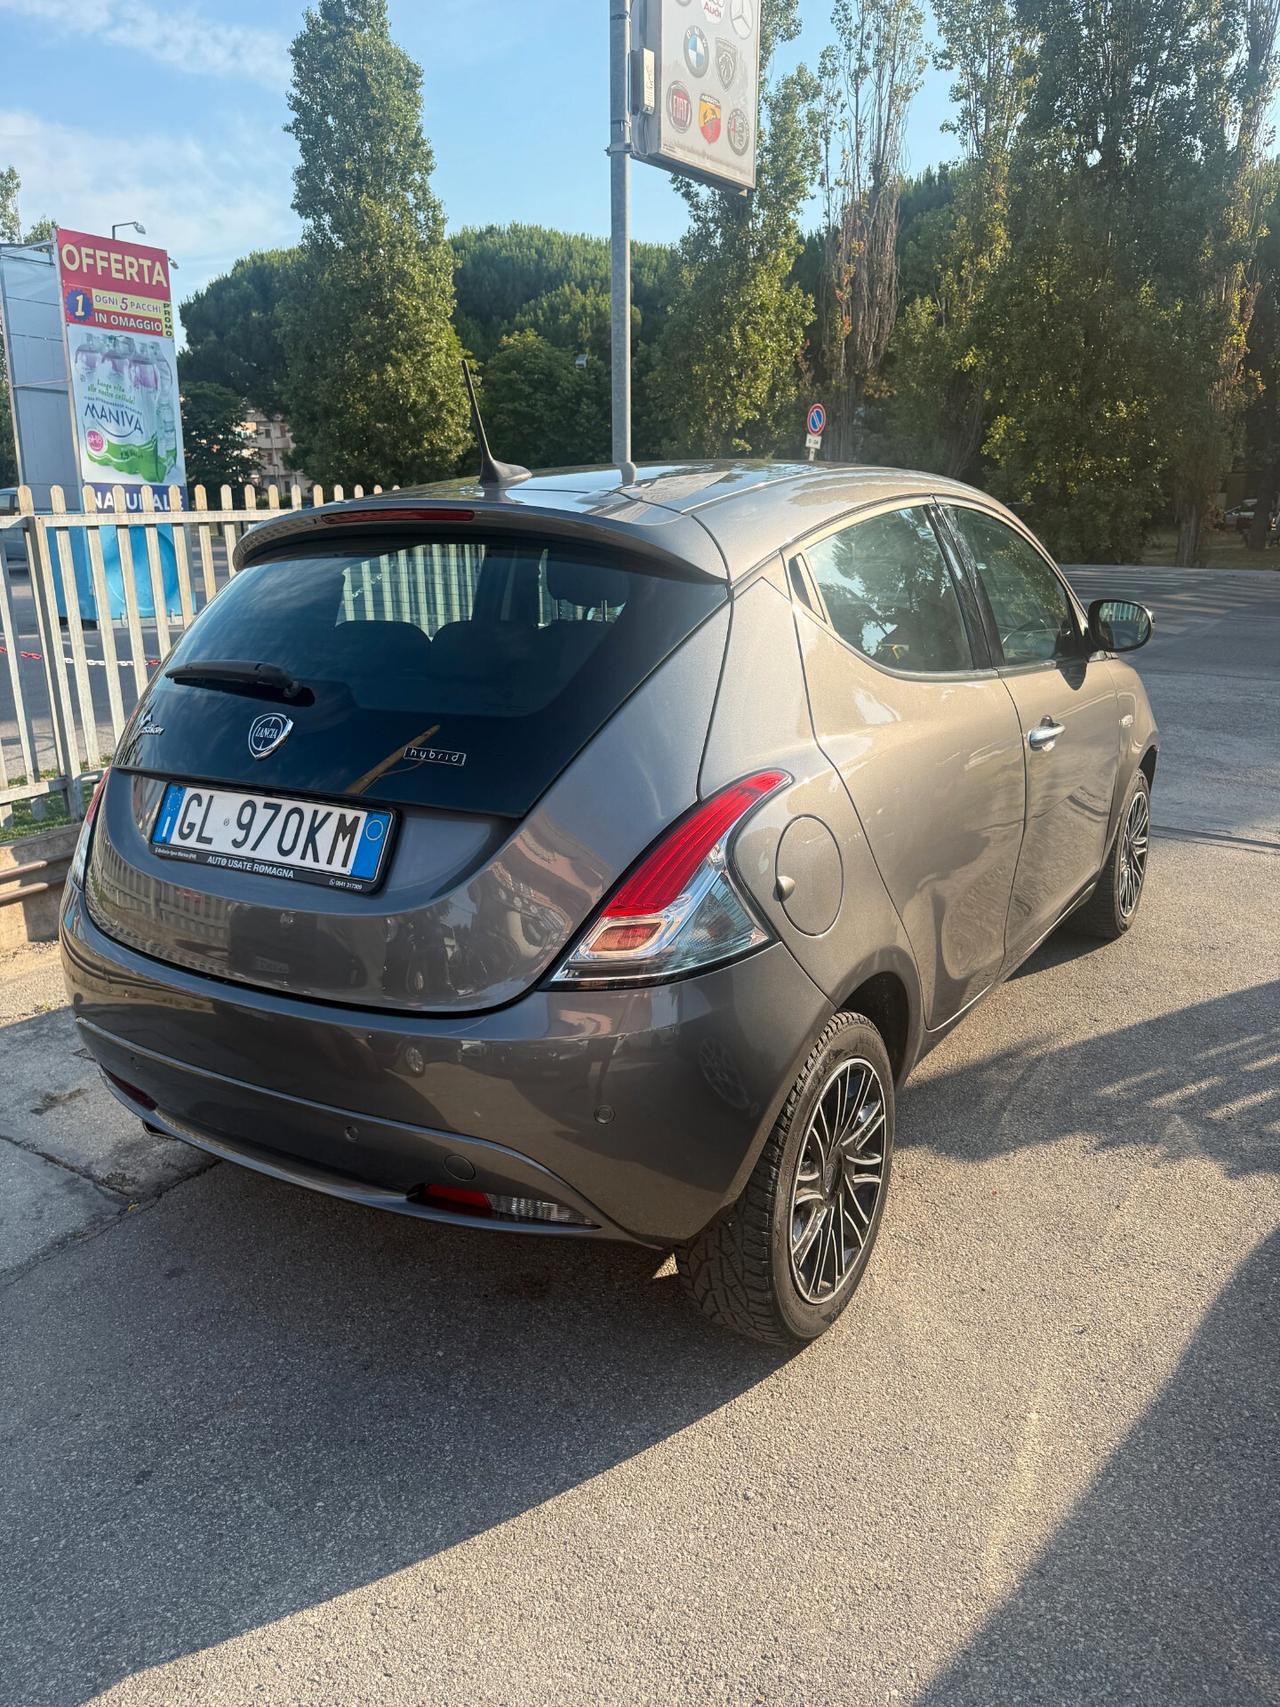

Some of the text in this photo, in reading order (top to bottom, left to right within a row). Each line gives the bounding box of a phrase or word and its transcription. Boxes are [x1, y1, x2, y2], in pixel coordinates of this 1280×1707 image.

[673, 95, 688, 122] FIAT
[61, 243, 168, 287] OFFERTA
[75, 294, 85, 317] 1
[95, 294, 161, 313] OGNI 5 PACCHI
[95, 312, 163, 332] IN OMAGGIO
[163, 303, 173, 337] PROMO
[84, 403, 144, 435] MANIVA
[255, 727, 278, 740] LANCIA
[410, 748, 460, 762] hybrid
[178, 793, 360, 868] GL 970KM
[206, 856, 295, 879] AUTO USATE ROMAGNA
